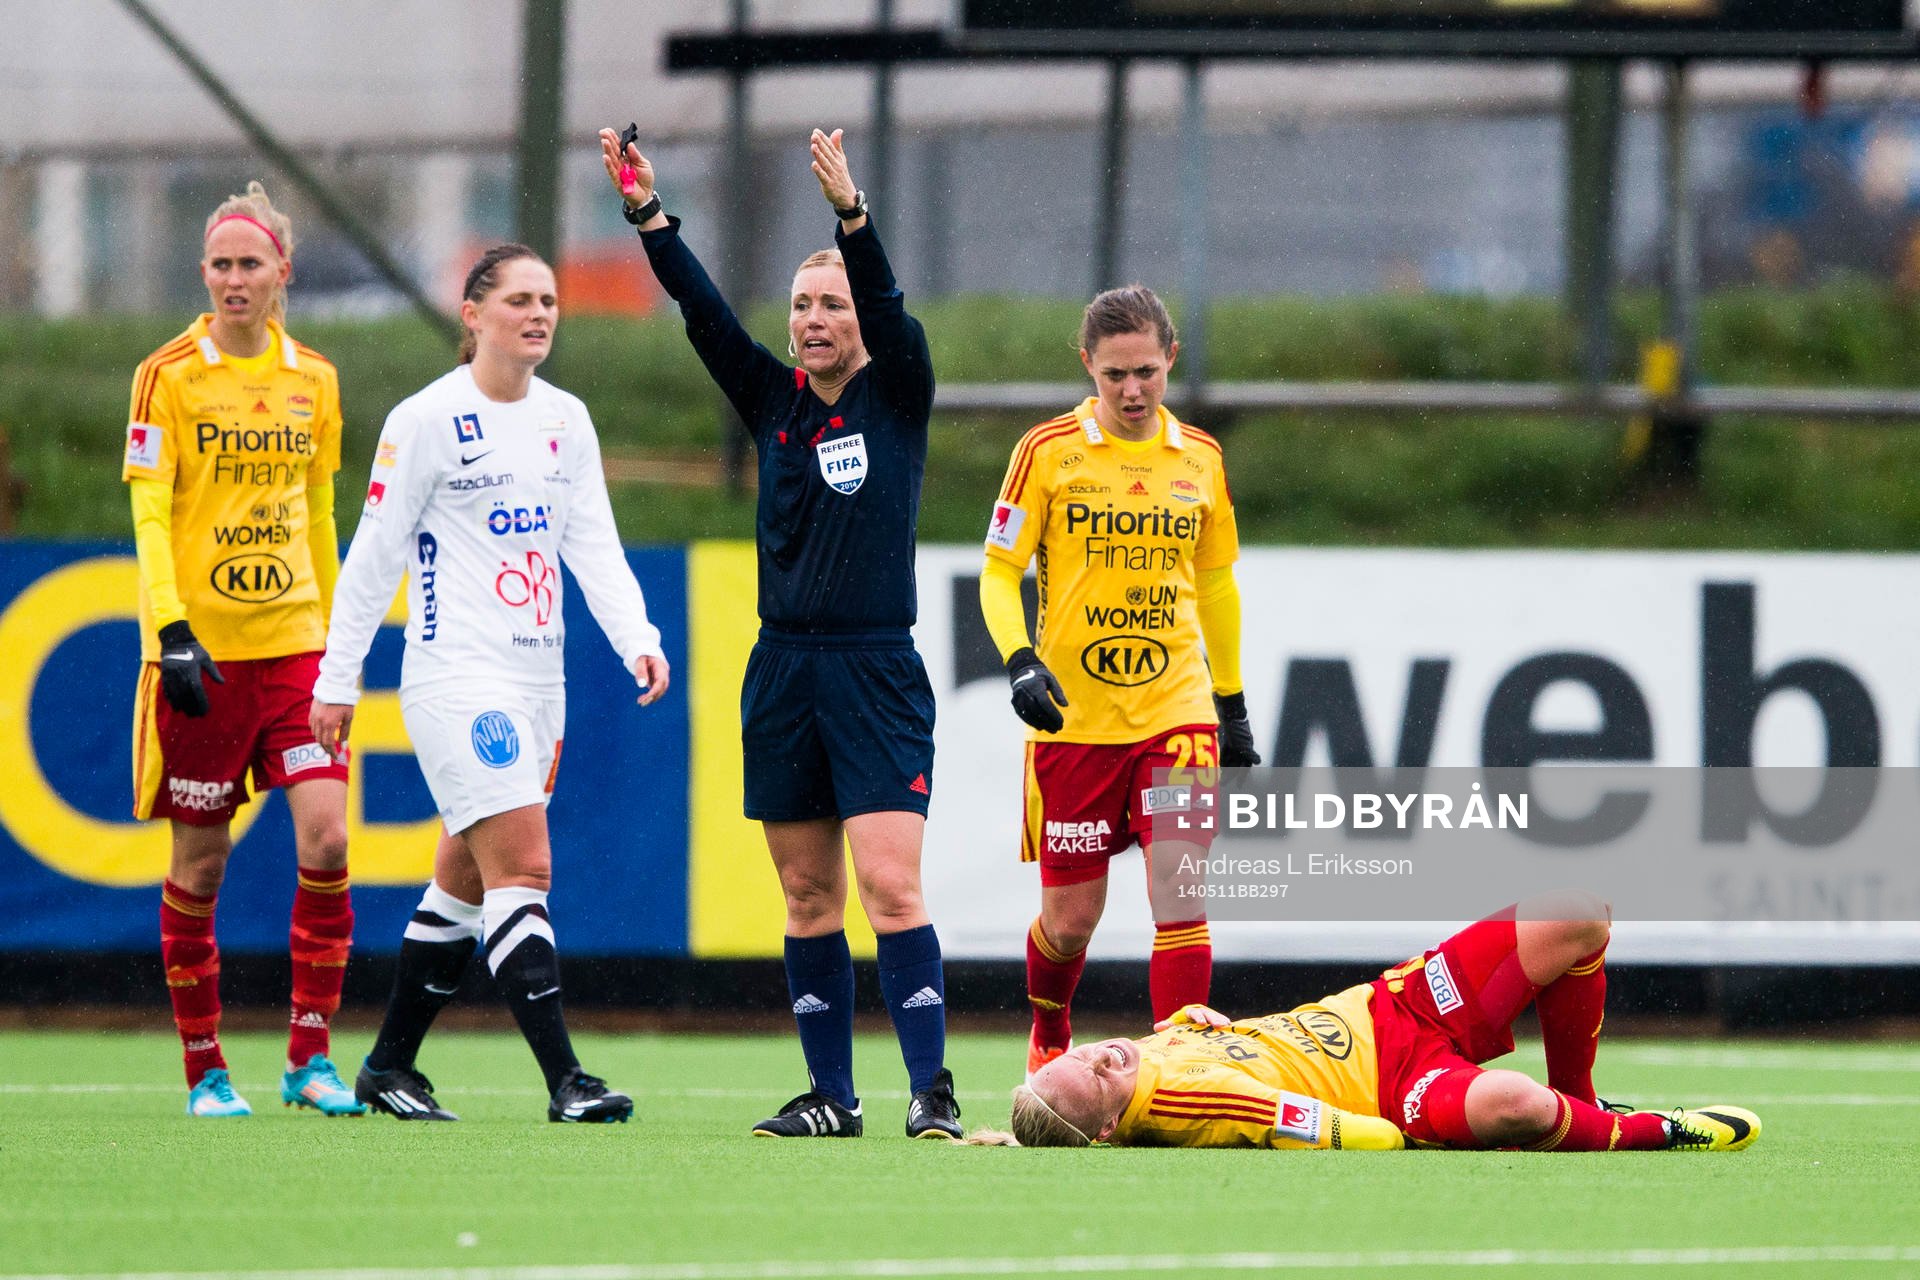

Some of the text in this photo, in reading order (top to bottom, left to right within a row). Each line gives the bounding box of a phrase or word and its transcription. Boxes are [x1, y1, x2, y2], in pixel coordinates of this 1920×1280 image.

[820, 438, 861, 455] REFEREE
[826, 456, 862, 474] FIFA
[449, 471, 514, 492] stadium
[840, 481, 858, 490] 2014
[1068, 484, 1112, 494] stadium
[487, 501, 552, 535] ÖBA
[1066, 503, 1198, 541] Prioritet
[214, 525, 291, 545] WOMEN
[1085, 536, 1180, 571] Finans
[1148, 585, 1178, 605] UN
[1085, 605, 1175, 630] WOMEN
[512, 632, 540, 648] Hem
[1221, 582, 1919, 848] web
[288, 745, 328, 767] BDO
[1165, 733, 1216, 788] 25
[168, 776, 234, 799] MEGA
[1045, 820, 1112, 838] MEGA
[1047, 836, 1108, 854] KAKEL
[1426, 960, 1453, 1006] BDO
[793, 1002, 830, 1014] adidas
[902, 996, 943, 1009] adidas
